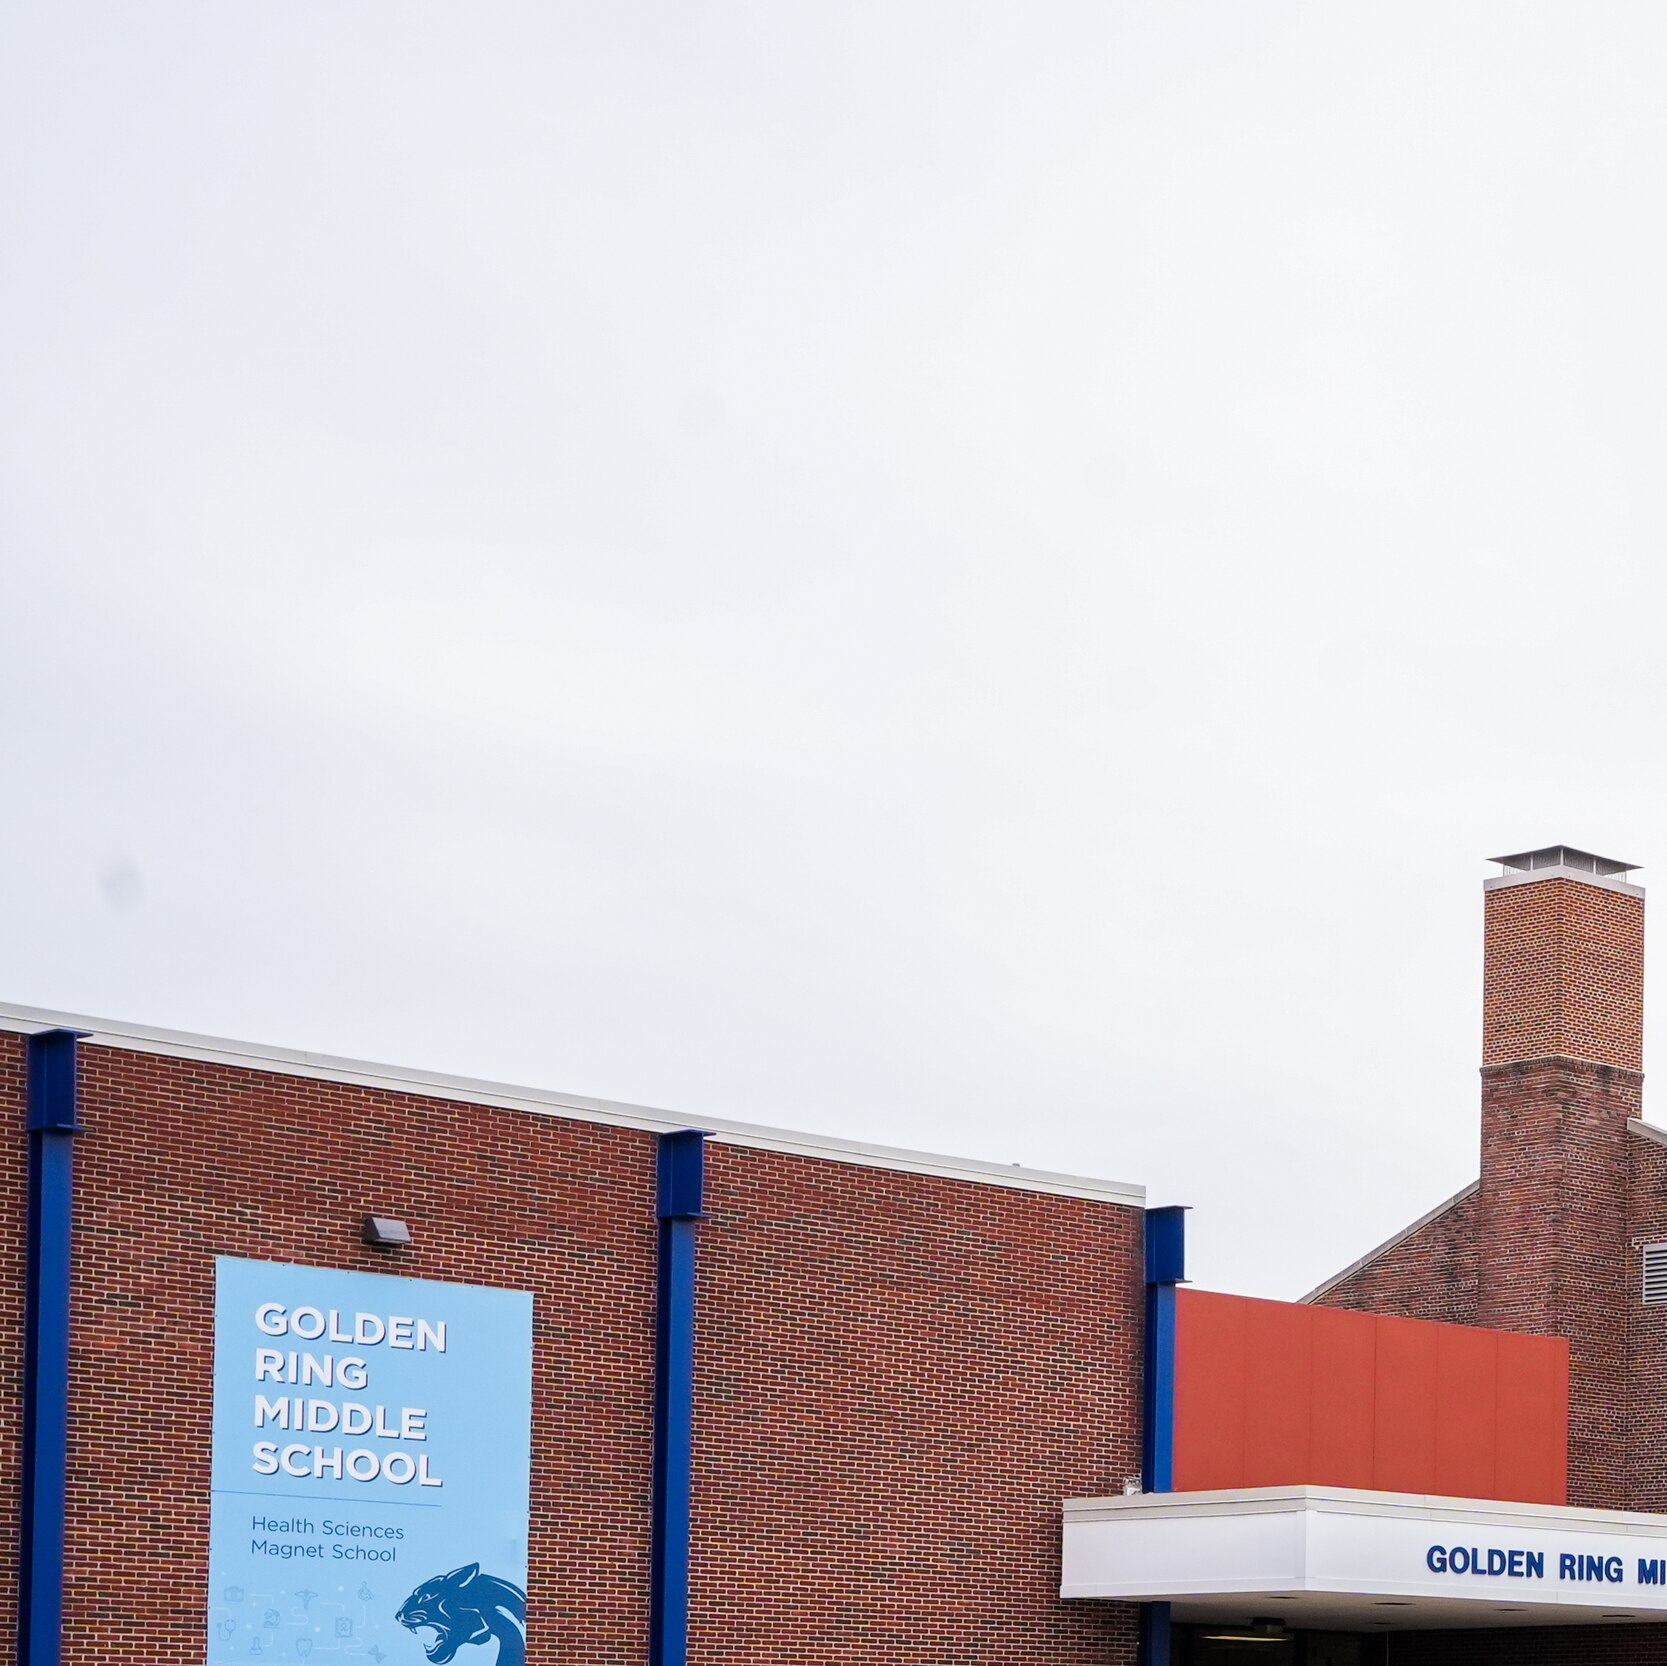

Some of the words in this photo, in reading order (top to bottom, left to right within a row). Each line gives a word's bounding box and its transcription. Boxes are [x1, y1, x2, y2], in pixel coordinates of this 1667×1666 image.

[255, 1302, 447, 1353] GOLDEN
[255, 1348, 368, 1390] RING
[254, 1395, 427, 1441] MIDDLE
[252, 1441, 443, 1487] SCHOOL
[252, 1515, 315, 1535] Health
[322, 1519, 405, 1541] Sciences
[251, 1539, 325, 1560] Magnet
[332, 1543, 397, 1563] School
[1426, 1545, 1545, 1580] GOLDEN
[1559, 1553, 1625, 1584] RING
